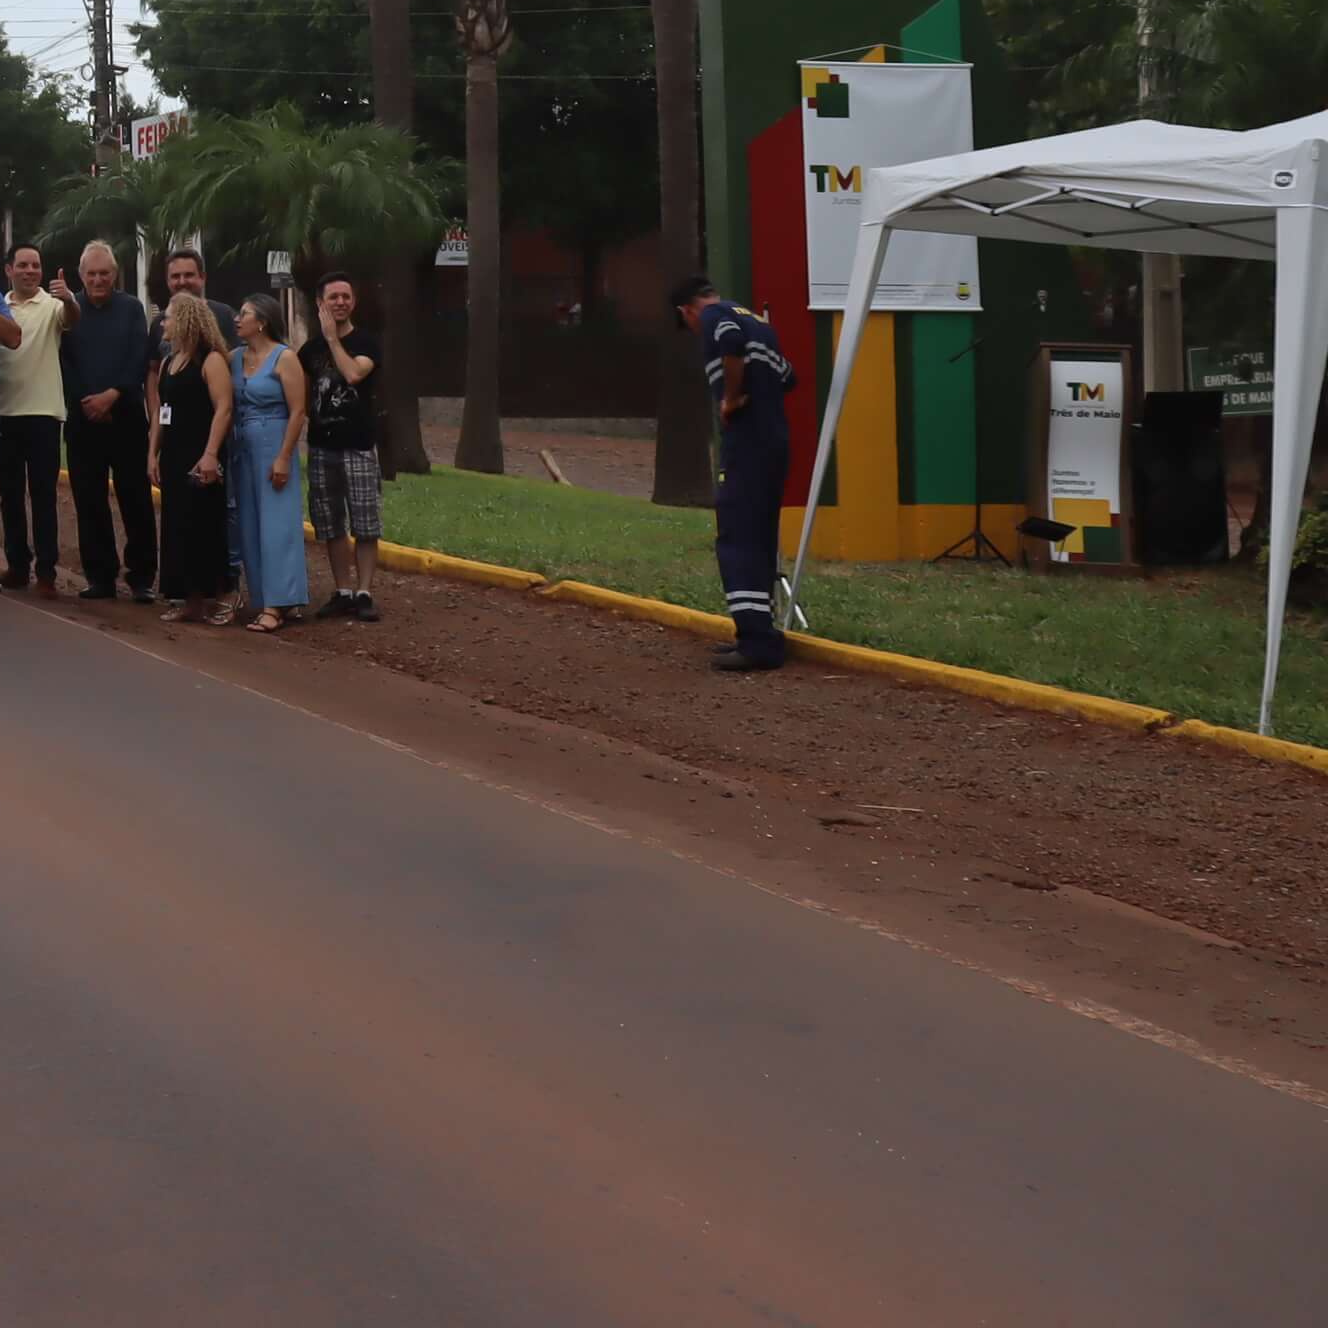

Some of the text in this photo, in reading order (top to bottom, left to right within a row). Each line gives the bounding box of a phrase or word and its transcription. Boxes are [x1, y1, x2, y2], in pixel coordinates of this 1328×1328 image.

[809, 164, 862, 193] TM
[1066, 381, 1105, 402] TM
[1231, 392, 1246, 405] DE
[1248, 391, 1274, 404] MAI
[1050, 408, 1121, 419] Três de Maio
